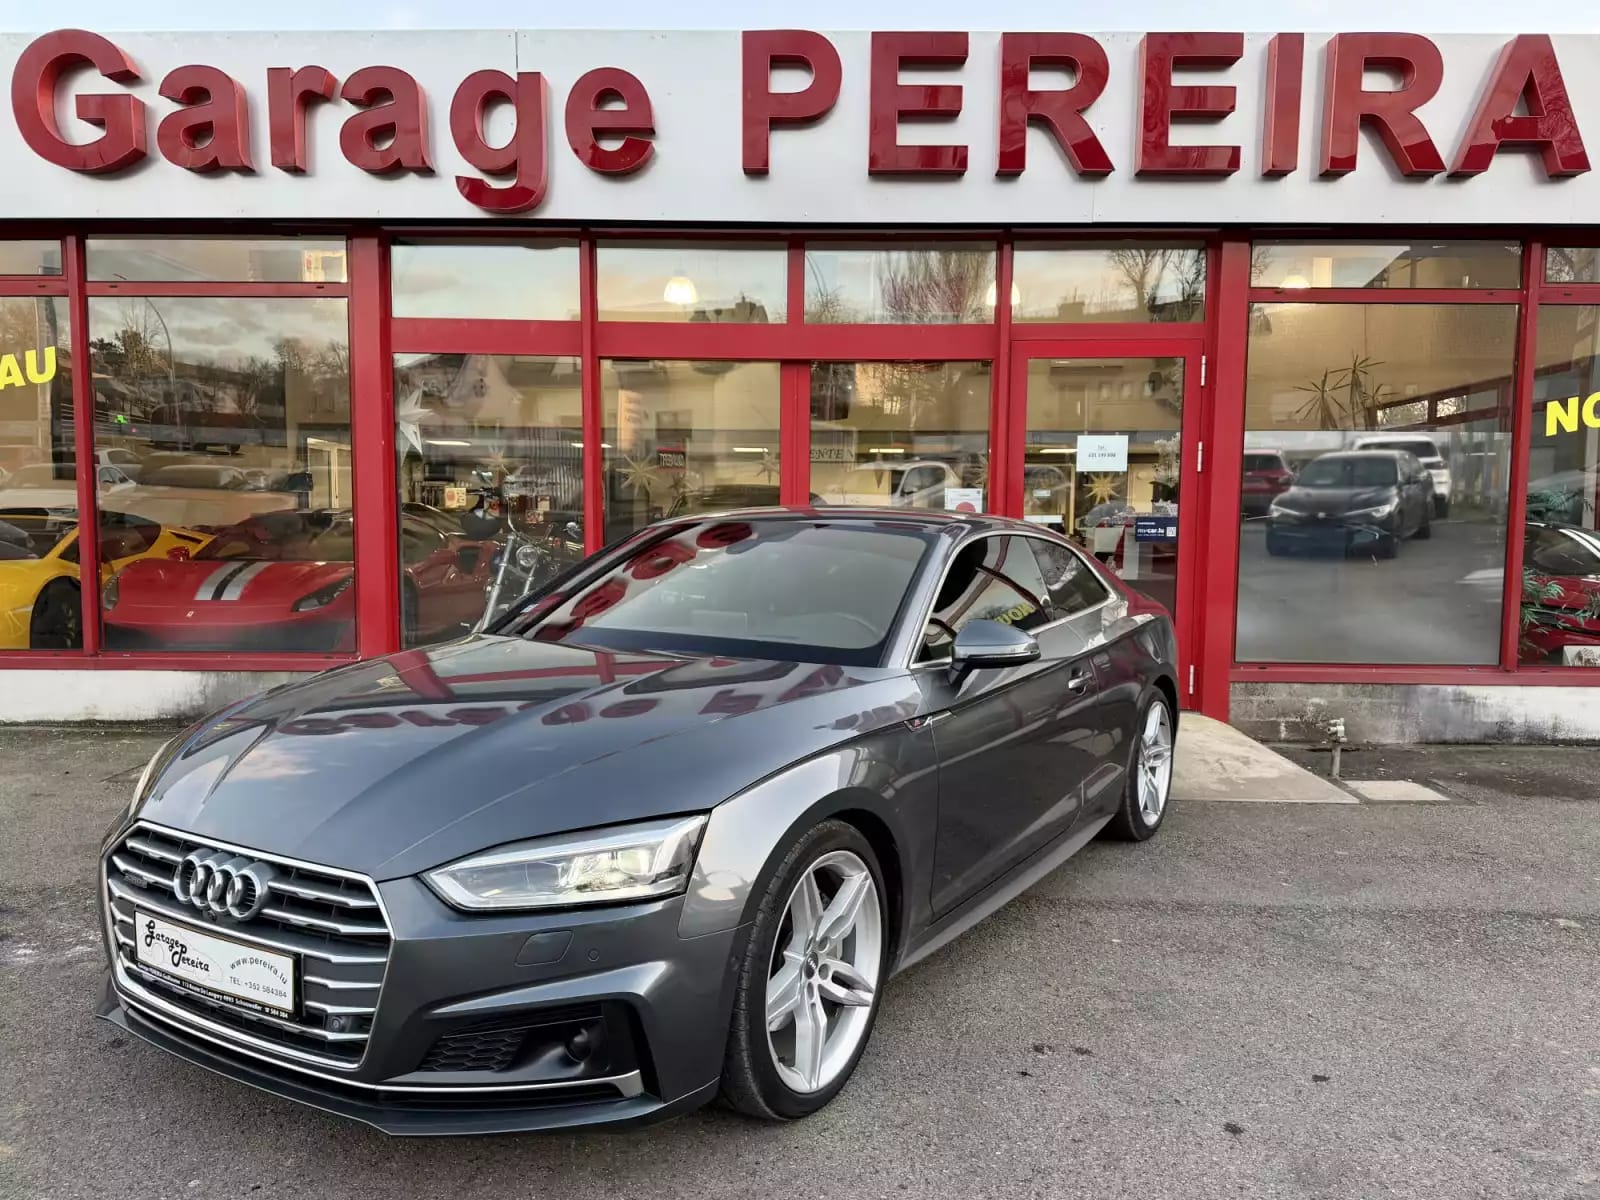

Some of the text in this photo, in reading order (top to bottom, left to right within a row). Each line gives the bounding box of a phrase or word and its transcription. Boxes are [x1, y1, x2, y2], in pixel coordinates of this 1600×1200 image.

[11, 28, 1592, 214] Garage PEREIRA
[144, 919, 181, 952] Garage
[171, 943, 211, 973] Pereira
[230, 956, 288, 985] www.pereira.lu
